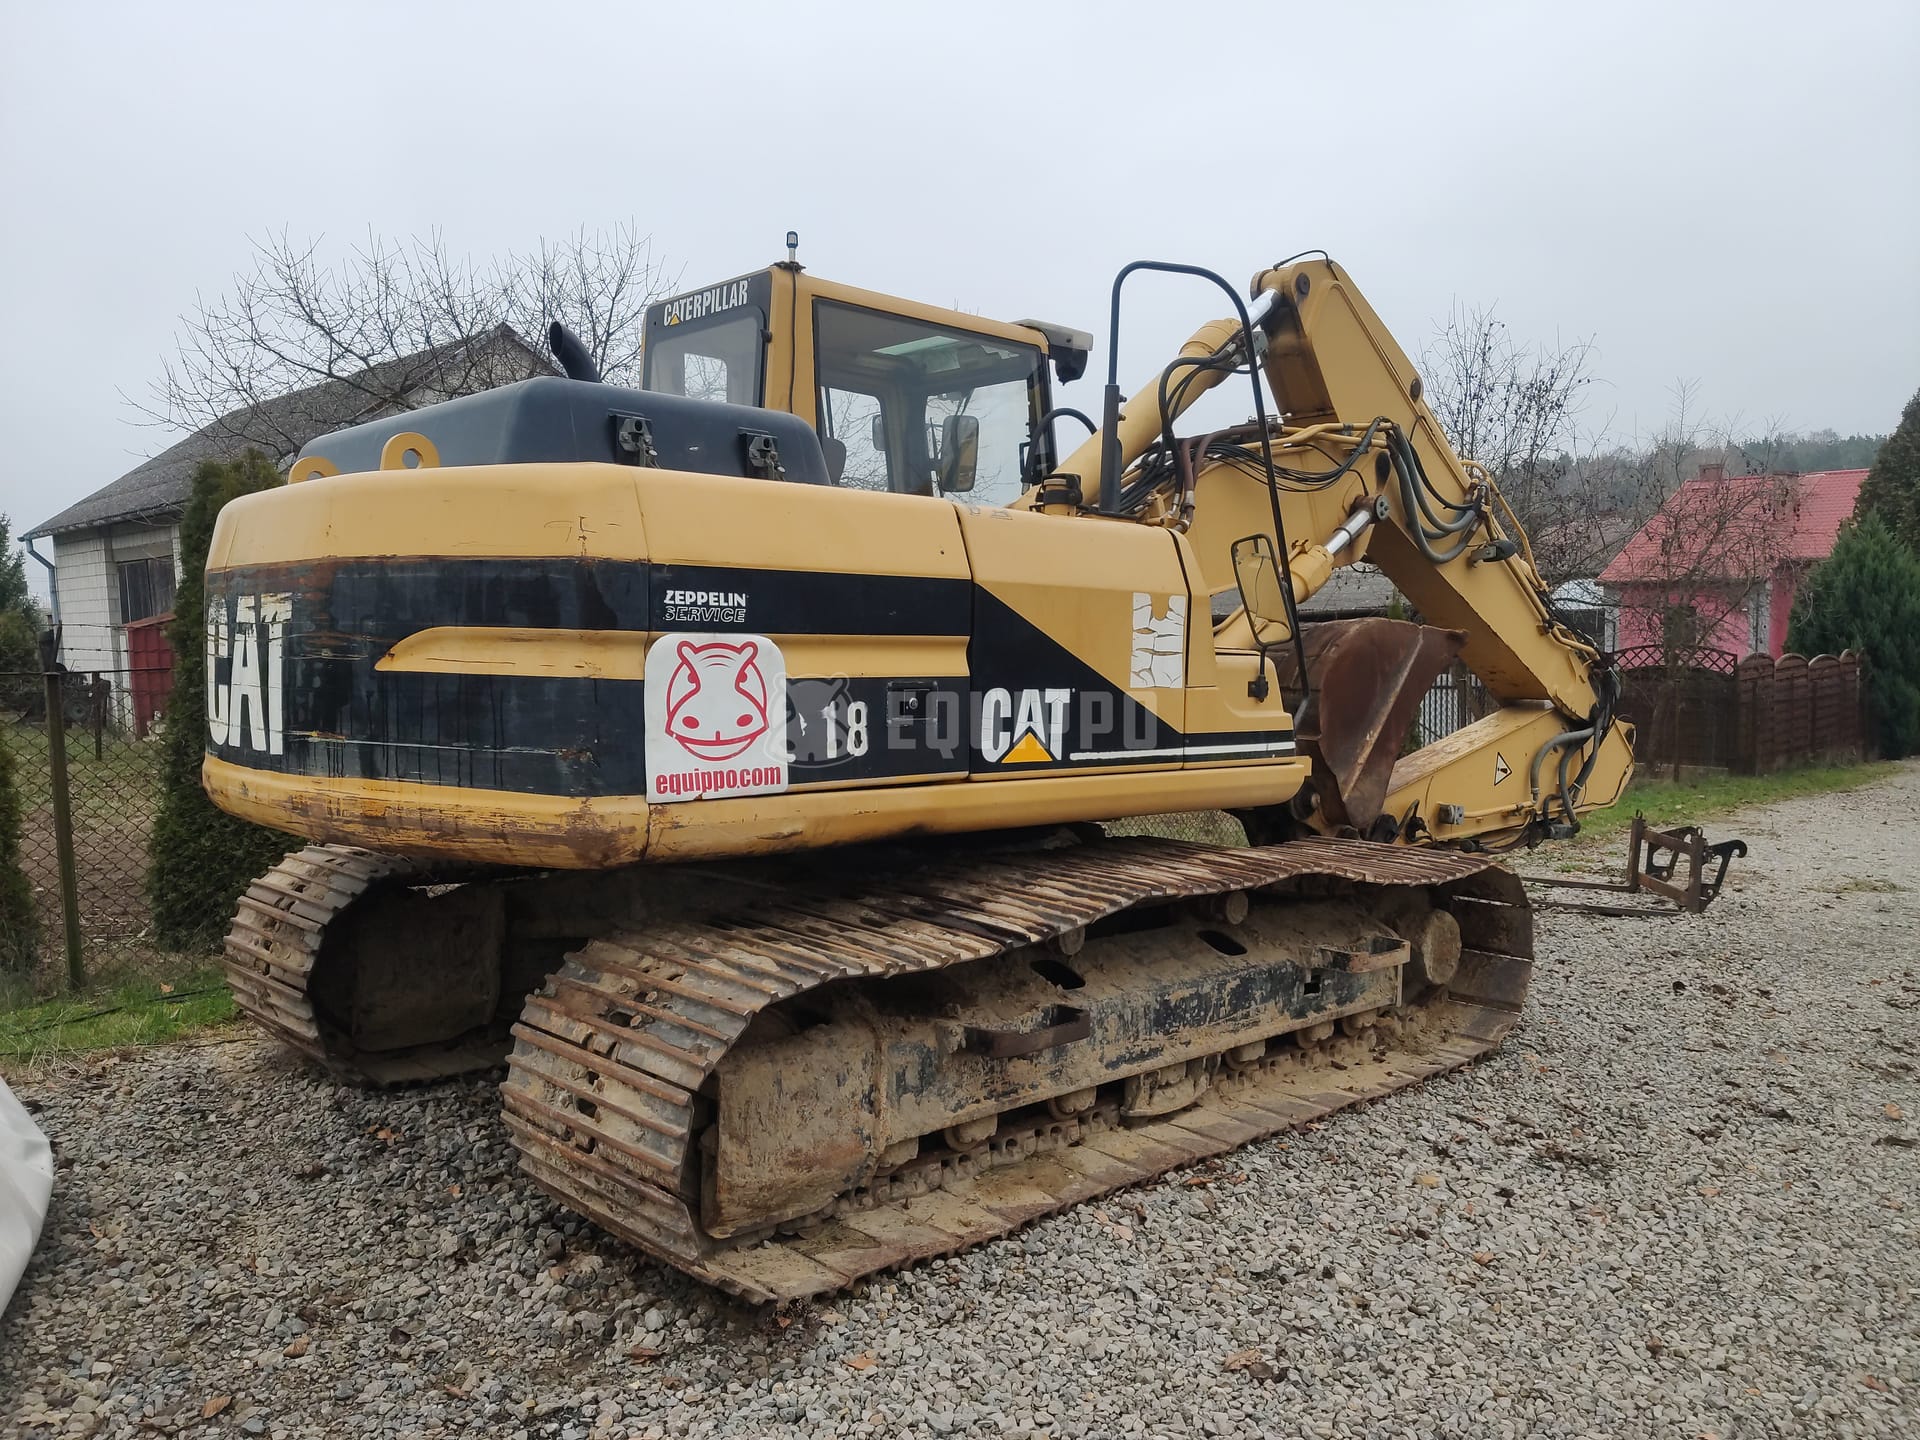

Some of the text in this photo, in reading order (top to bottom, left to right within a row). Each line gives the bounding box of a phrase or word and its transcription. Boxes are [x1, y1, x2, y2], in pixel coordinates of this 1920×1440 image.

[663, 280, 748, 327] CATERPILLAR
[663, 590, 746, 607] ZEPPELIN
[663, 605, 746, 623] SERVICE
[207, 592, 293, 755] CAT
[981, 687, 1070, 763] CAT
[655, 766, 781, 795] equippo.com
